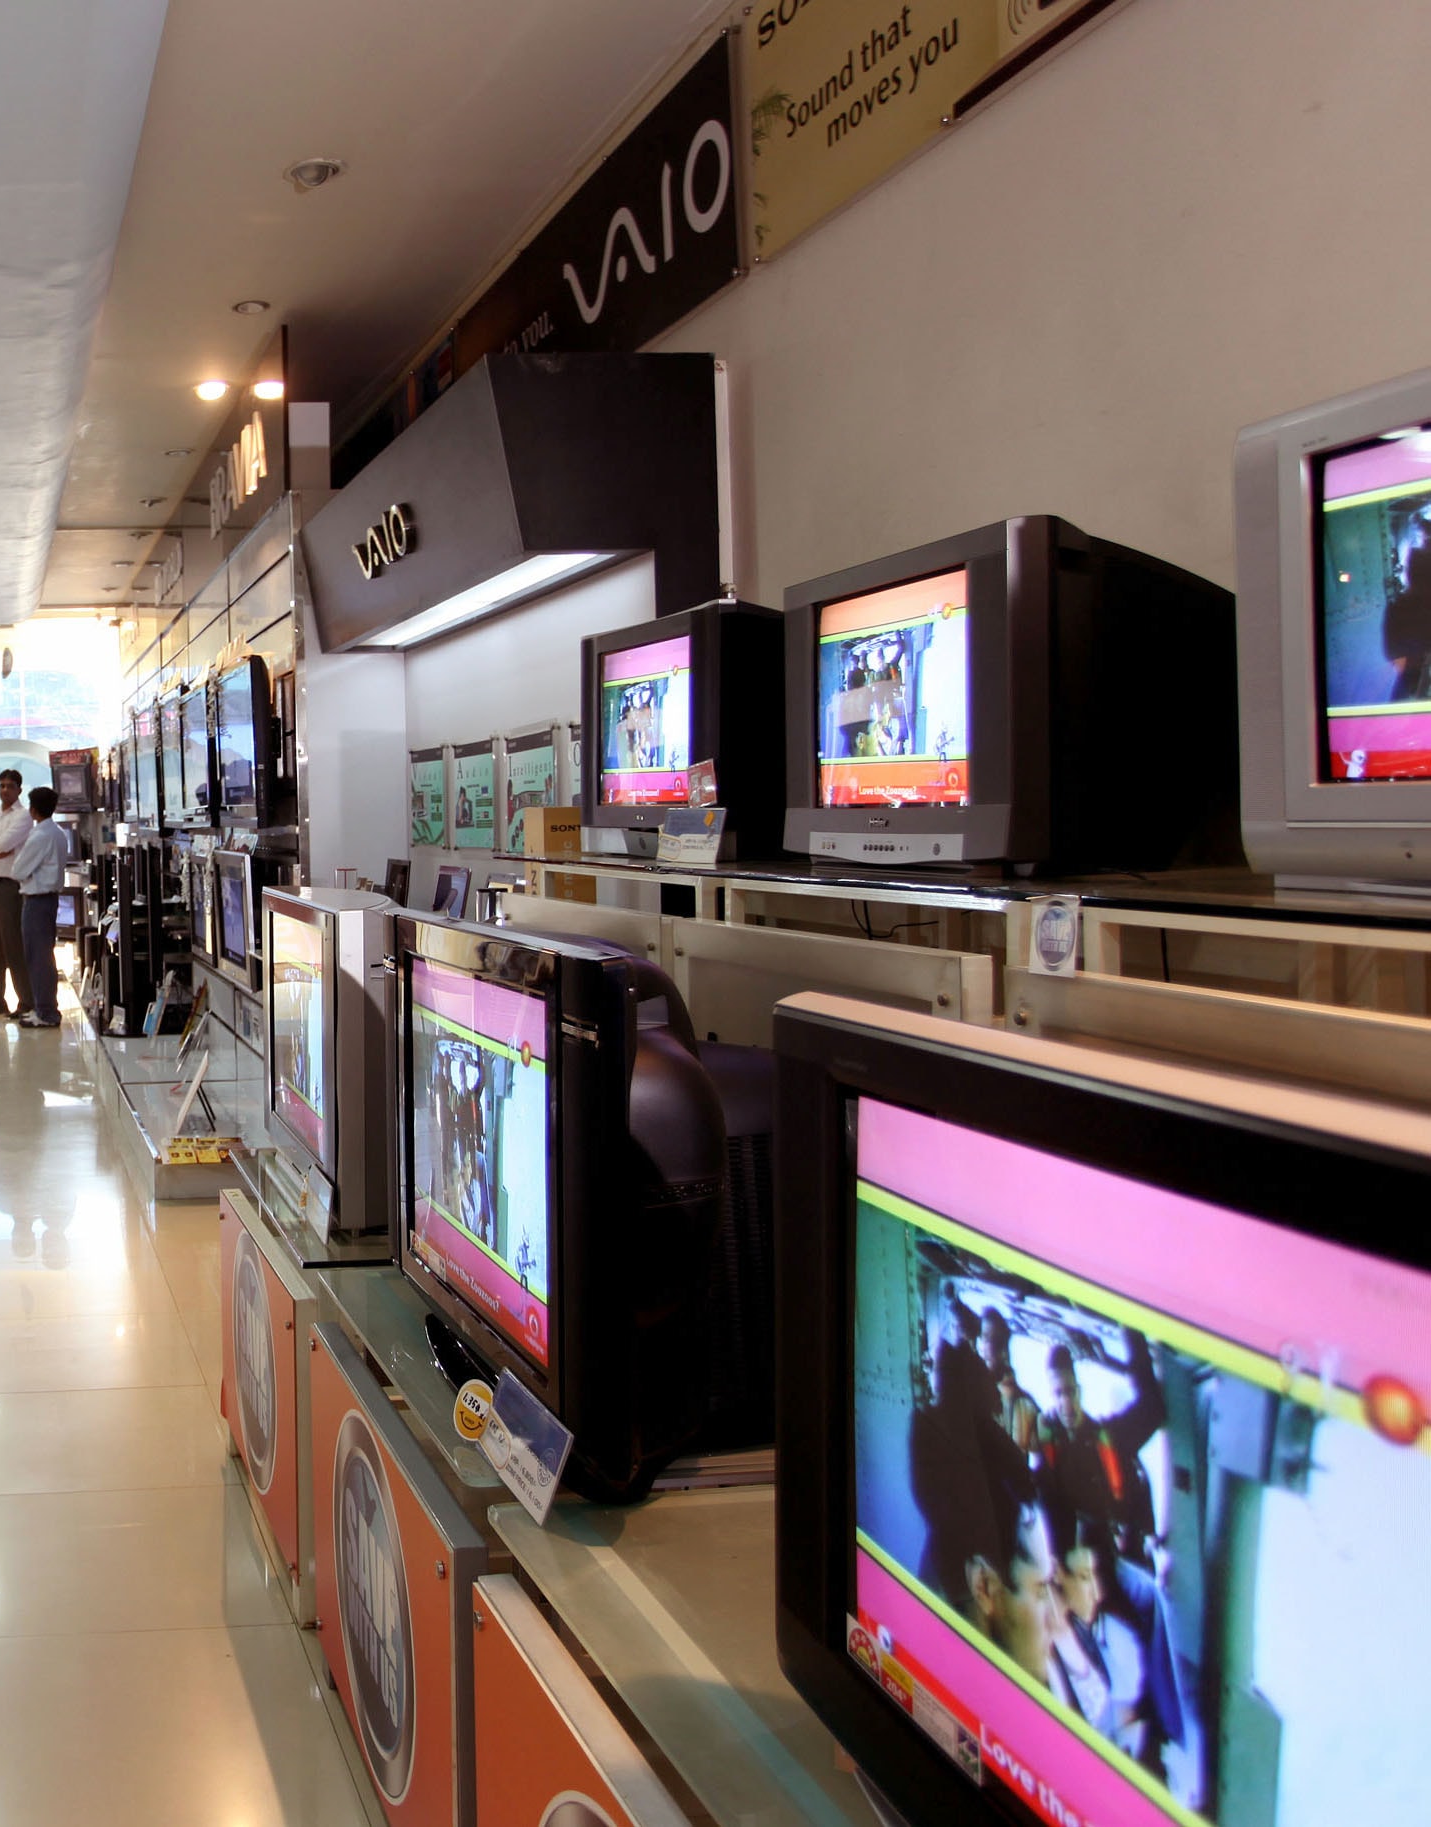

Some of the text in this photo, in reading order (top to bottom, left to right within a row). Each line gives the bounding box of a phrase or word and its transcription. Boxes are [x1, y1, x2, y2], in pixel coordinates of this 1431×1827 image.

[758, 0, 811, 48] SO
[787, 5, 912, 138] Sound that
[827, 18, 959, 147] moves you
[563, 120, 730, 324] VAIO
[351, 503, 409, 580] VAIO
[239, 1287, 268, 1399] SAVE
[346, 1488, 397, 1668] SAVE
[347, 1573, 398, 1730] WITH US
[980, 1722, 1081, 1827] Love the
